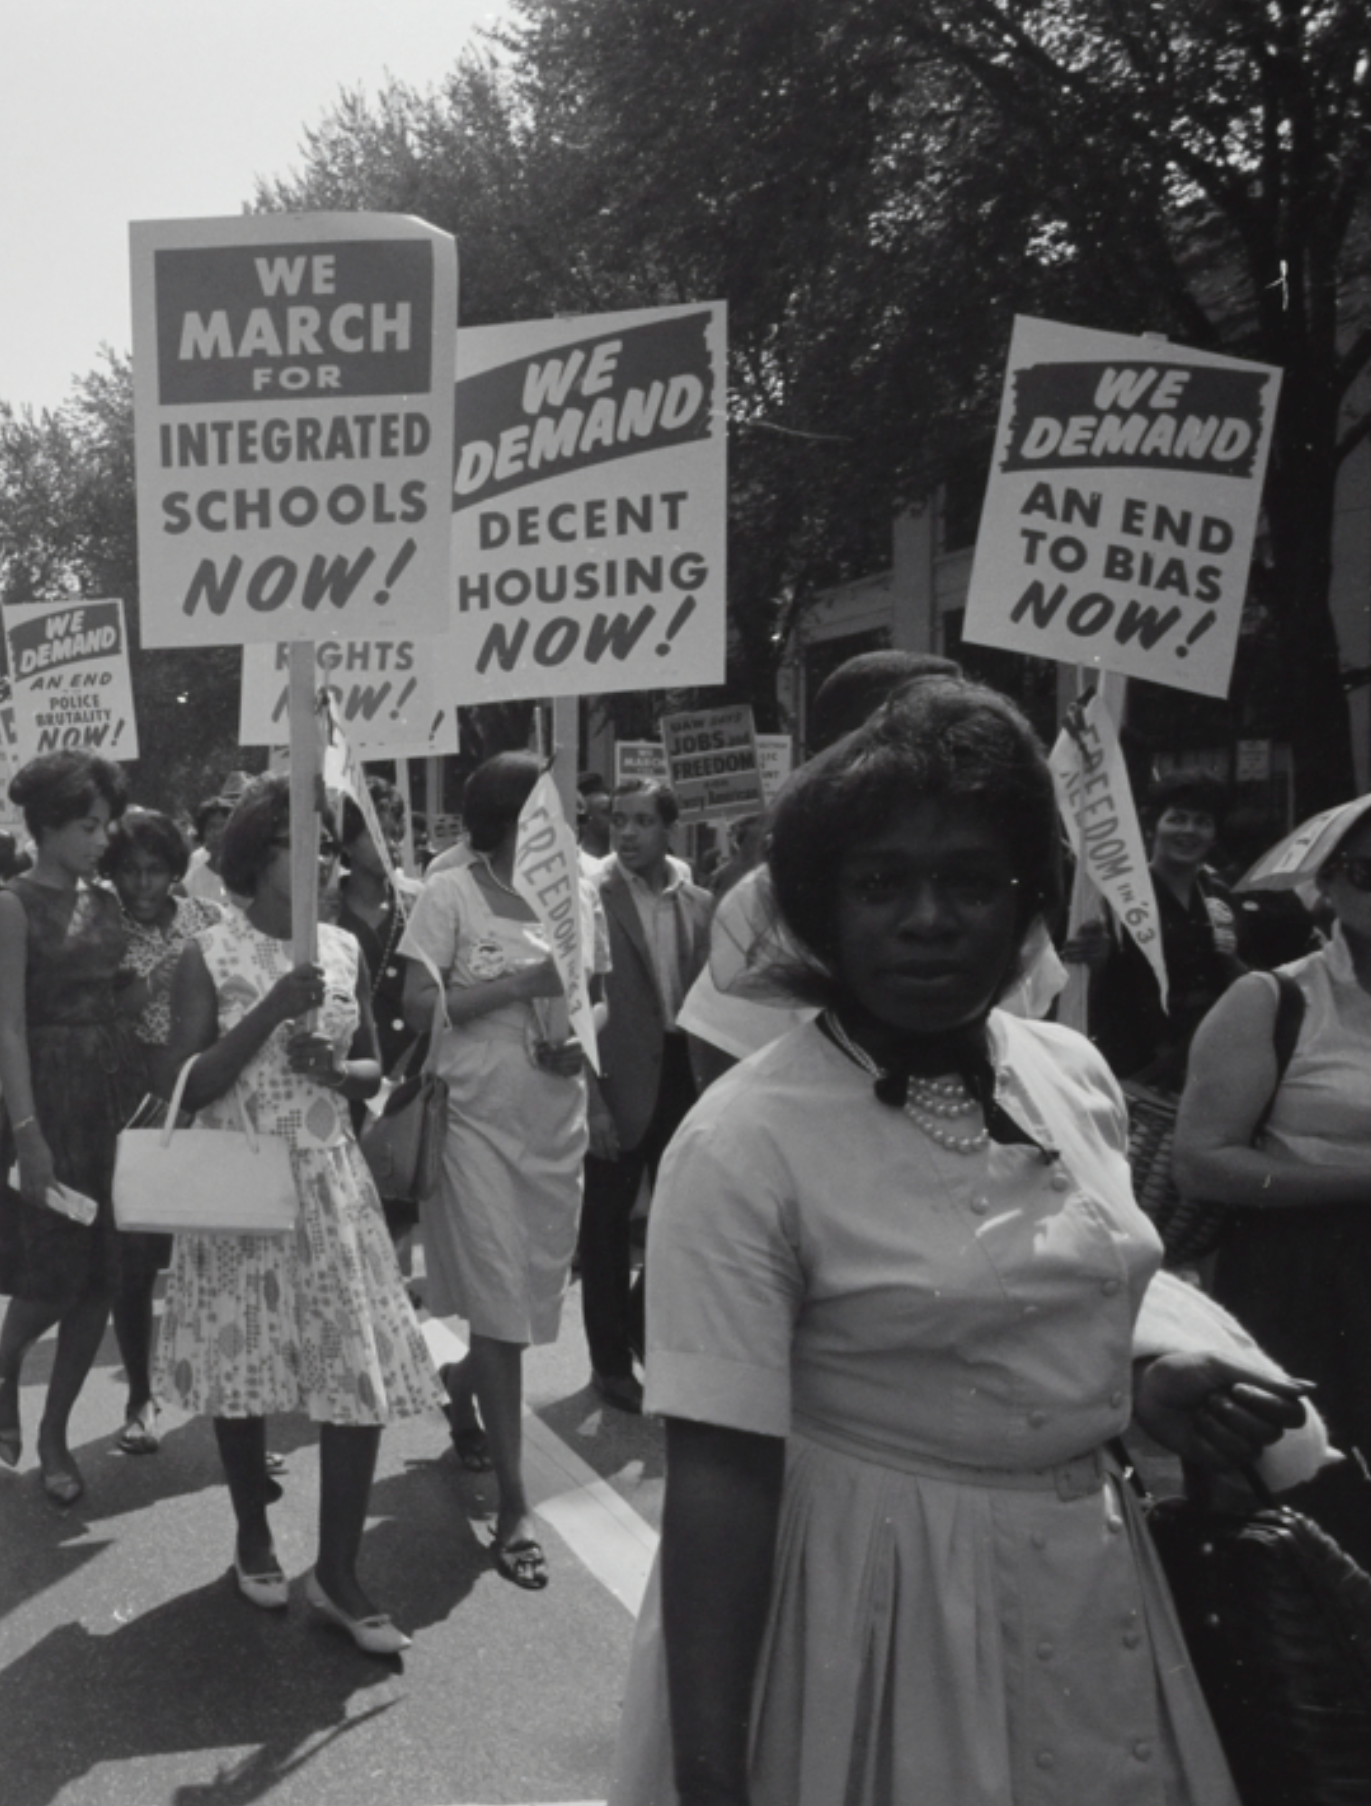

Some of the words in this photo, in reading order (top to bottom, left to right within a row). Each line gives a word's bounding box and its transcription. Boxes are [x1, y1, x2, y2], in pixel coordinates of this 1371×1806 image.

[254, 254, 337, 297] WE
[178, 301, 412, 361] MARCH
[252, 364, 342, 391] FOR
[522, 339, 623, 414] WE
[1093, 366, 1191, 411] WE
[159, 412, 432, 469] INTEGRATED
[454, 374, 704, 497] DEMAND
[1020, 413, 1253, 462] DEMAND
[162, 479, 428, 535] SCHOOLS
[479, 491, 689, 550] DECENT
[1020, 481, 1103, 528] AN
[1121, 498, 1234, 555] END
[182, 537, 418, 617] NOW!
[459, 551, 708, 612] HOUSING
[1020, 528, 1088, 574] TO
[1103, 544, 1223, 604] BIAS
[45, 609, 86, 640] WE
[475, 594, 697, 675] NOW!
[1009, 580, 1217, 660] NOW!
[19, 625, 117, 674] DEMAND
[275, 641, 414, 671] RGHTS
[30, 674, 64, 692] AN
[70, 672, 113, 688] END
[50, 694, 100, 711] POLICE
[35, 709, 112, 728] BRUTALITY
[37, 717, 126, 753] NOW!
[671, 730, 725, 757] JOBS
[673, 750, 756, 782] FREEDOM
[1125, 901, 1155, 945] '63
